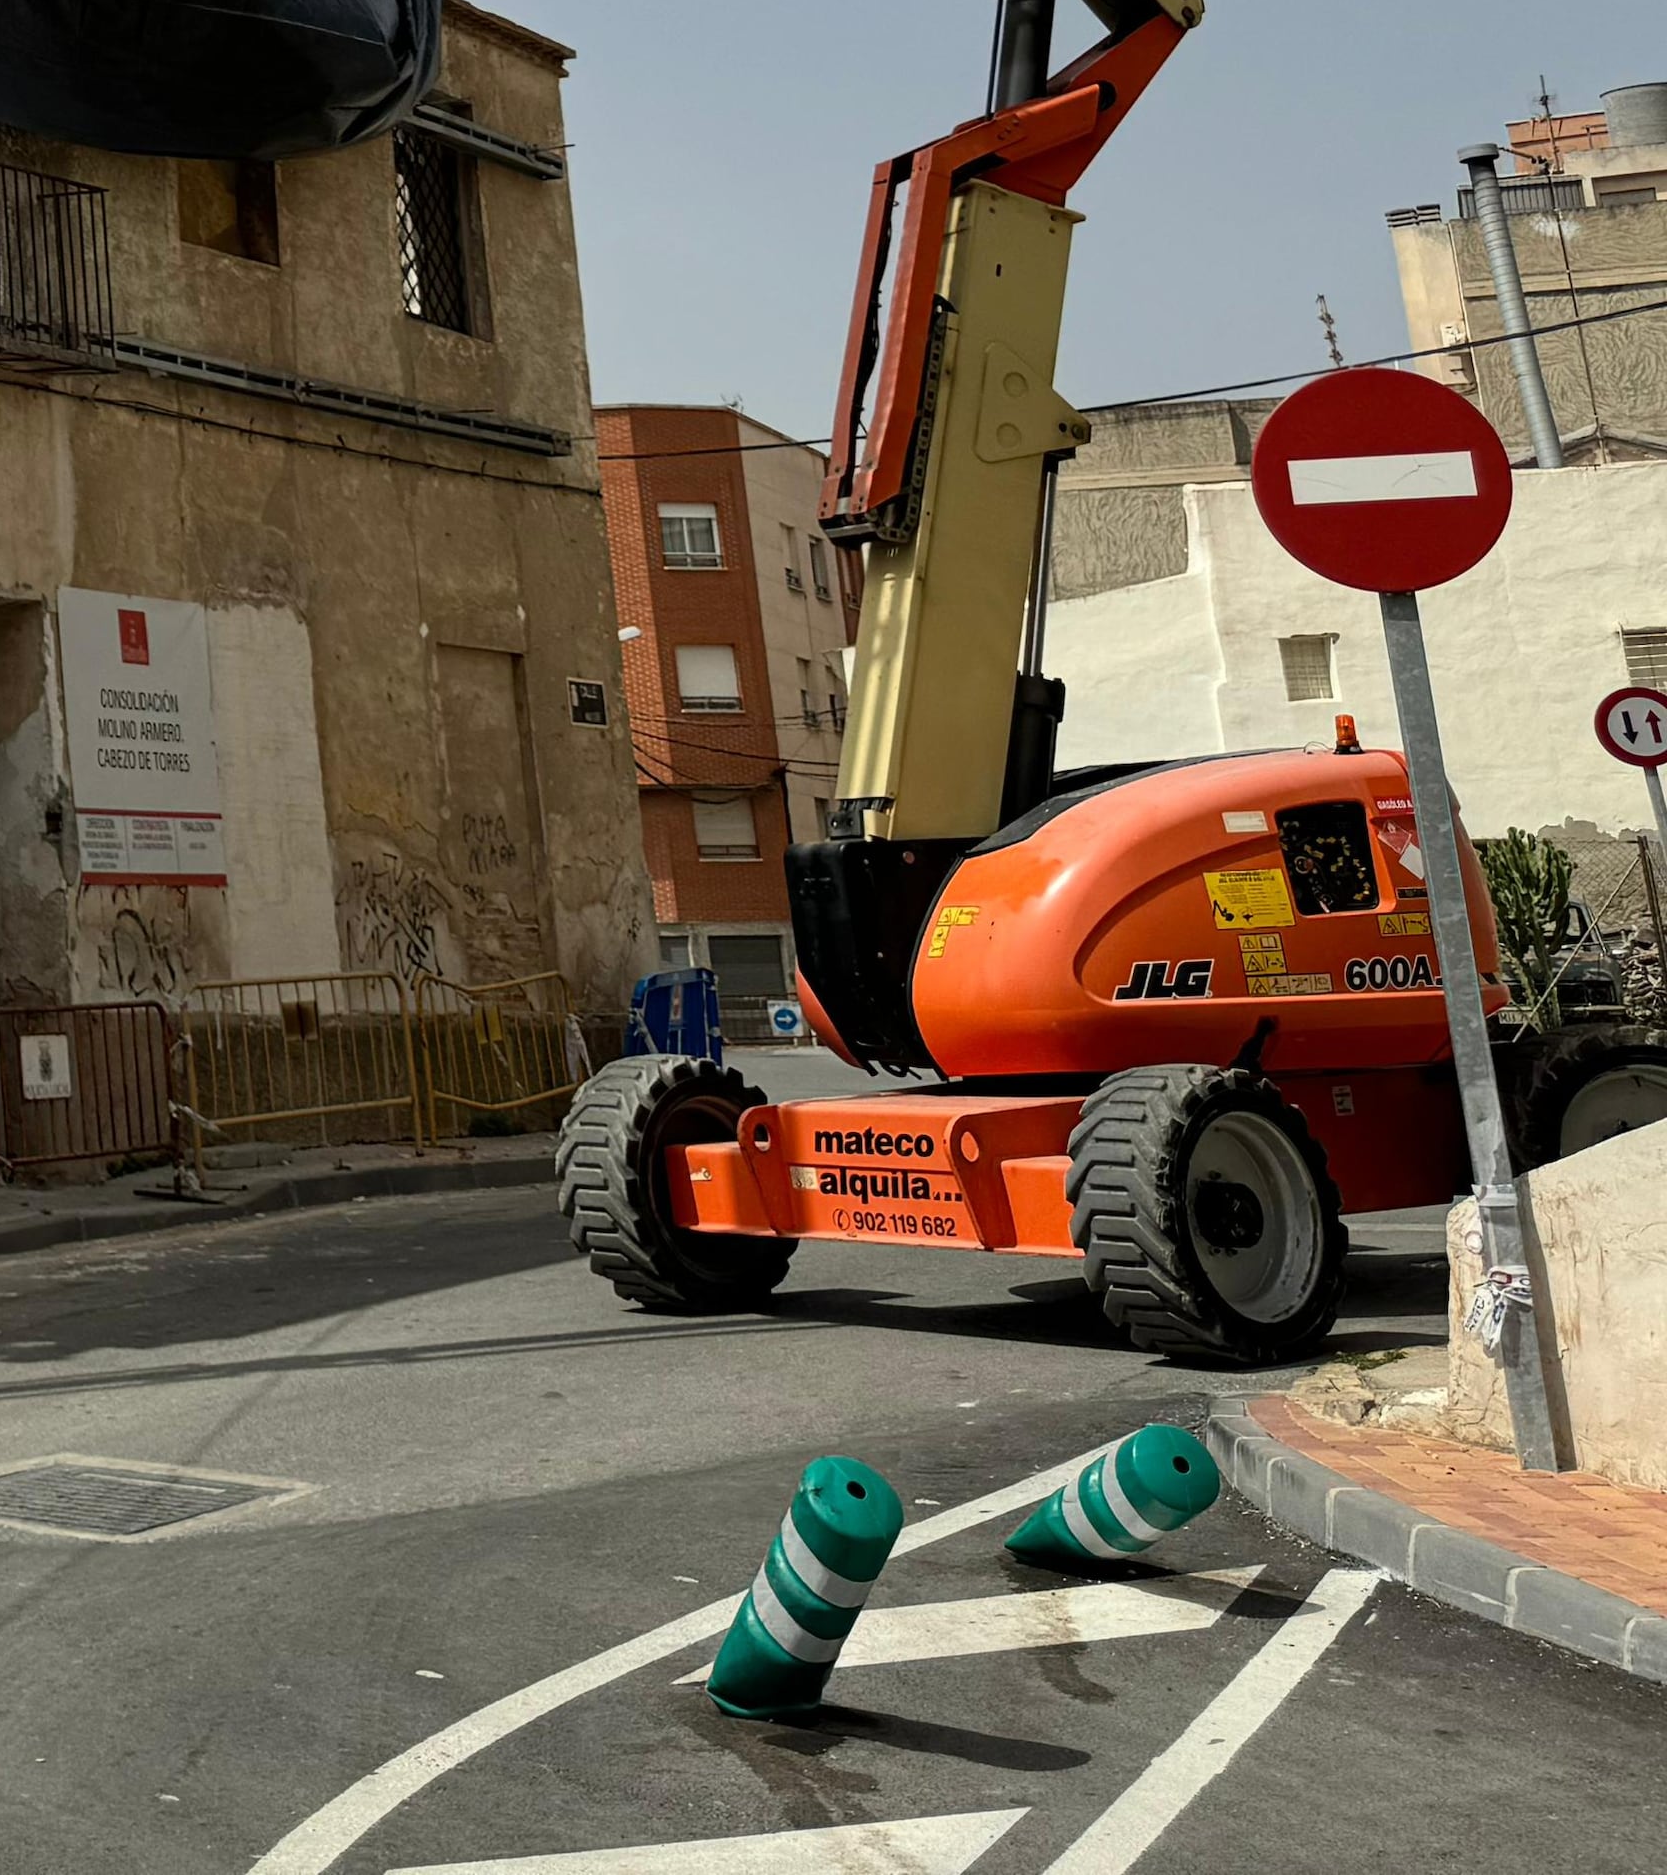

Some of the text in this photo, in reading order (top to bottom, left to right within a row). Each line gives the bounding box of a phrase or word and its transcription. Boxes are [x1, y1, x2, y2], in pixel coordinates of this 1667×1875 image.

[100, 688, 179, 713] CONSOLIDACIÓN
[98, 717, 137, 740] MOLINO
[97, 748, 191, 772] CABEZO DE TORRES
[1113, 959, 1214, 1001] JLG
[814, 1126, 935, 1158] mateco
[853, 1211, 957, 1237] 902 119 682
